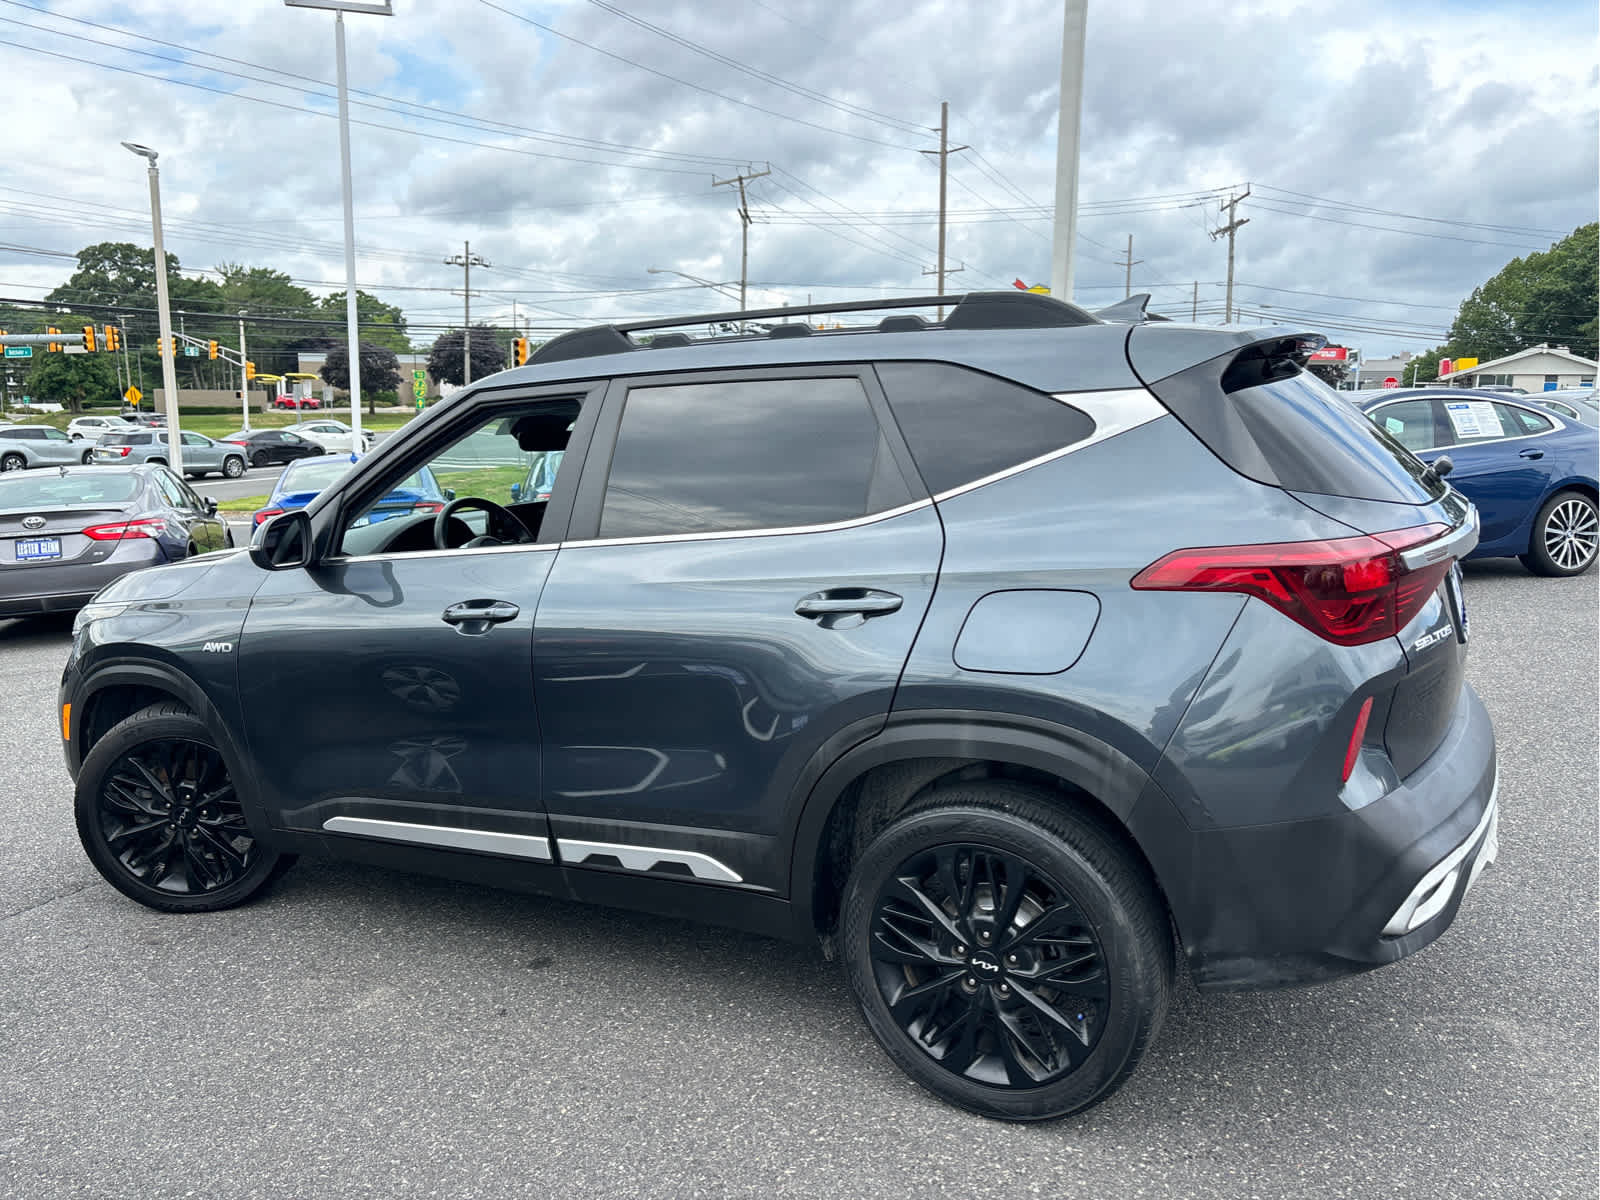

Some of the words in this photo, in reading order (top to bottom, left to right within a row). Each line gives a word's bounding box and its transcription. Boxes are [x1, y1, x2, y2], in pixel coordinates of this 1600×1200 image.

[17, 542, 39, 556] LESTER
[40, 540, 60, 553] GLENN
[1414, 624, 1453, 651] SELTOS
[202, 642, 232, 653] AWD
